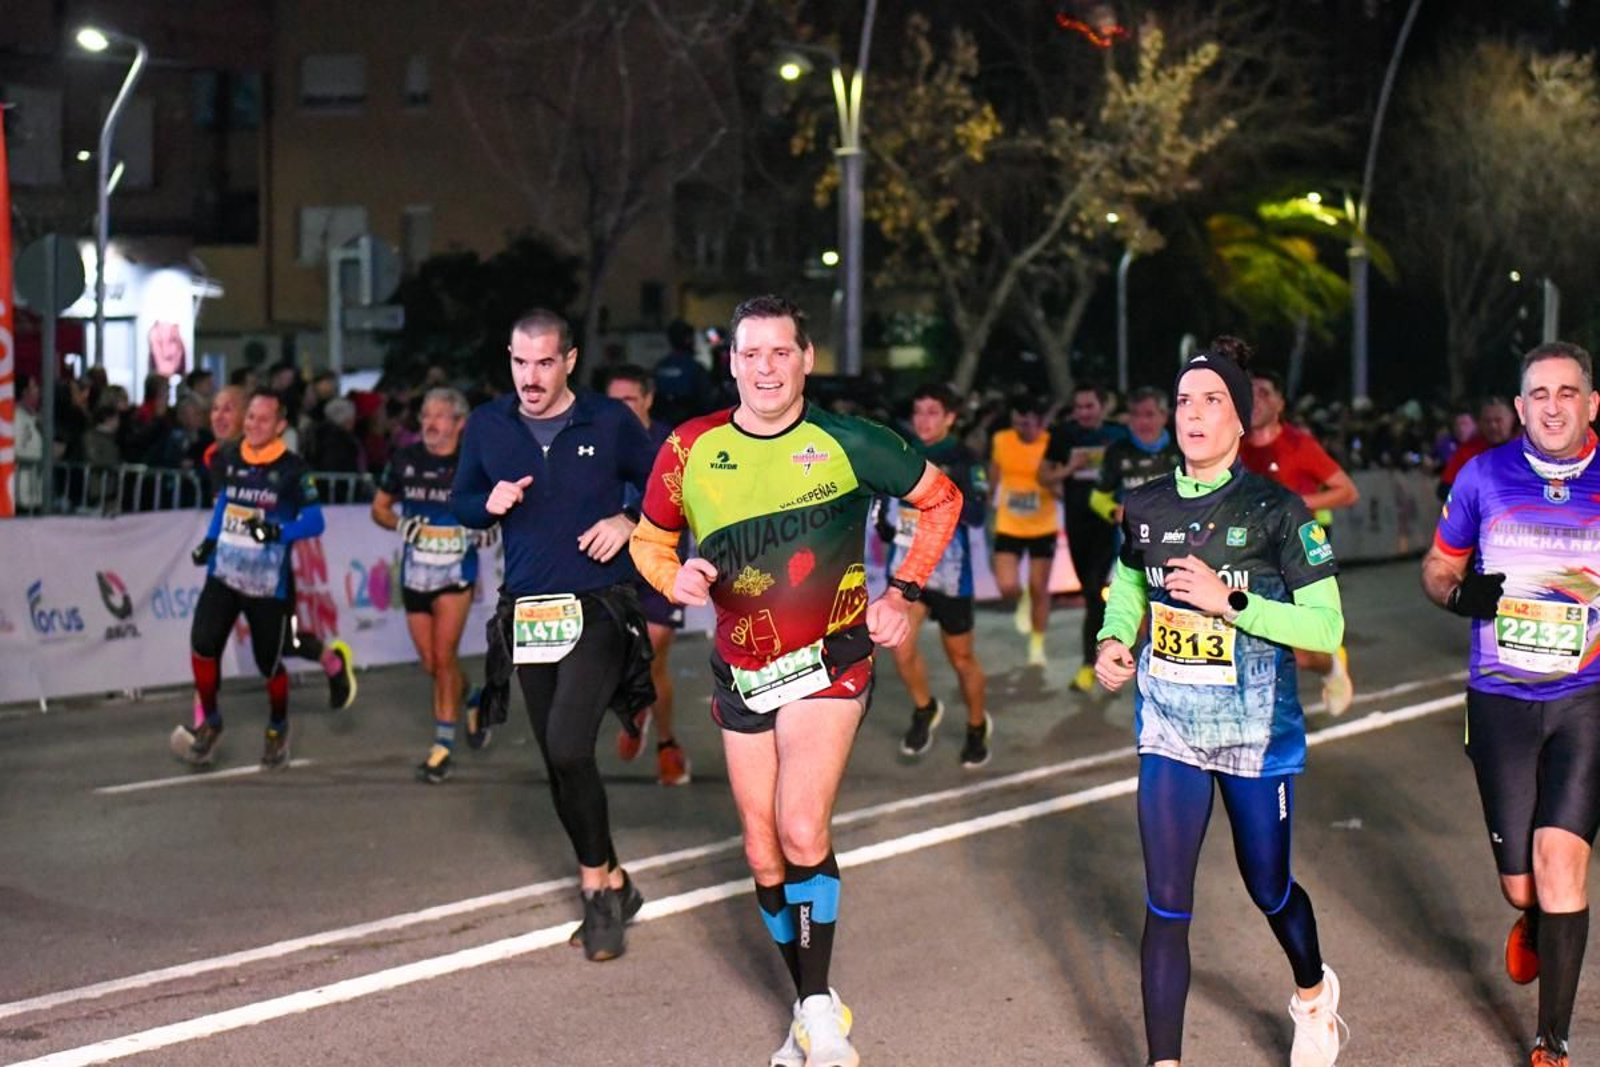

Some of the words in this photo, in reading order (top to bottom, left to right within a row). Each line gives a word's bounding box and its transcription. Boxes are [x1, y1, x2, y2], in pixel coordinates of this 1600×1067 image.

[709, 462, 738, 470] VIATOR
[779, 481, 838, 509] VALDEPEÑAS
[521, 619, 578, 641] 1479
[1158, 626, 1224, 658] 3313
[1502, 617, 1578, 650] 2232
